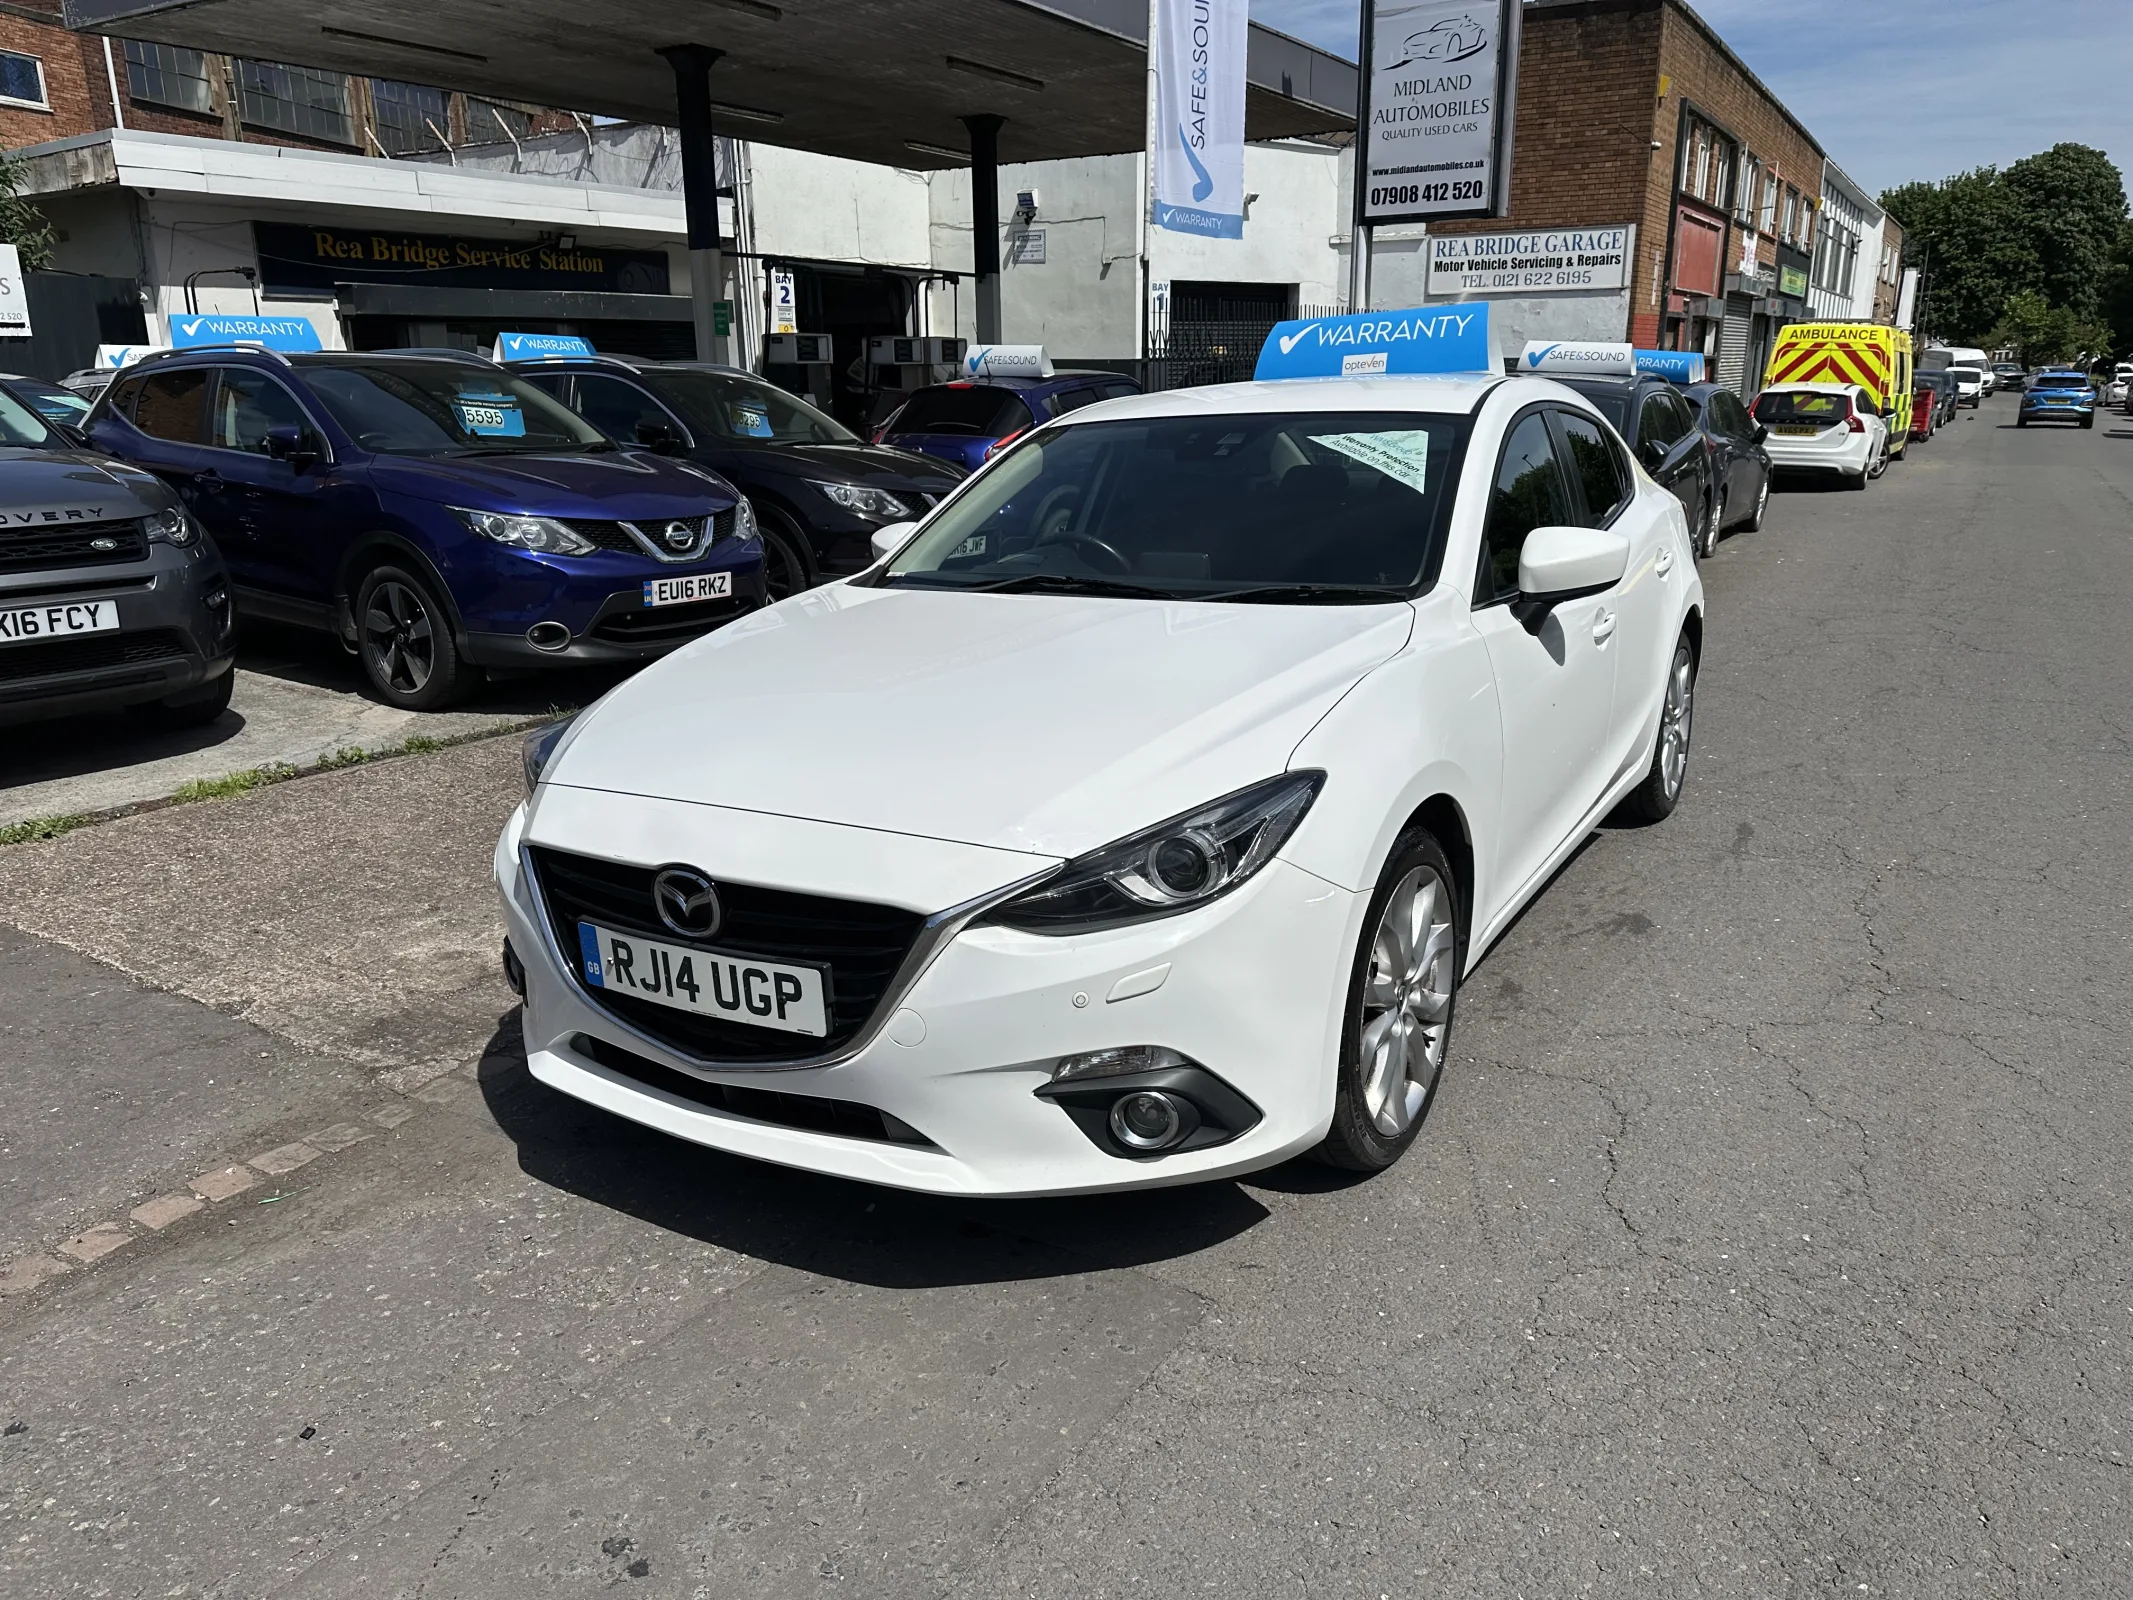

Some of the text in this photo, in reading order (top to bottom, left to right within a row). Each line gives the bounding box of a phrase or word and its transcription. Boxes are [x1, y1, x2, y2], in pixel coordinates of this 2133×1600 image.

[1191, 0, 1210, 150] SAFE&SOU
[1393, 74, 1472, 97] MIDLAND
[1373, 98, 1490, 124] AUTOMOBILES
[1382, 122, 1478, 141] QUALITY USED CARS
[1372, 159, 1485, 176] www.midlandautomobiles.co.uk
[1370, 180, 1483, 206] 07908 412 520
[1175, 211, 1223, 230] WARRANTY
[313, 232, 604, 273] Rea Bridge Service Station
[1435, 231, 1623, 258] REA BRIDGE GARAGE
[1434, 253, 1621, 273] Motor Vehicle Servicing & Repairs
[775, 275, 792, 284] BAY
[1152, 283, 1169, 291] BAY
[1461, 270, 1592, 288] TEL. 0121 622 6195
[780, 286, 791, 304] 2
[1156, 293, 1164, 310] 1
[7, 312, 22, 320] 520
[205, 320, 304, 336] WARRANTY
[1318, 313, 1475, 347] WARRANTY
[1789, 329, 1879, 340] AMBULANCE
[524, 338, 588, 353] WARRANTY
[126, 353, 147, 361] SAF
[983, 355, 1037, 365] SAFE&SOUND
[1549, 350, 1625, 362] SAFE&SOUND
[1637, 357, 1685, 370] RRANTY
[466, 409, 503, 424] 5595
[1331, 440, 1411, 478] Available on this car
[1342, 435, 1420, 473] Warranty Protection
[969, 538, 984, 552] JWF
[658, 575, 726, 601] EU16 RKZ
[46, 603, 100, 633] FCY
[587, 961, 600, 975] GB
[610, 938, 803, 1020] RJ14 UGP
